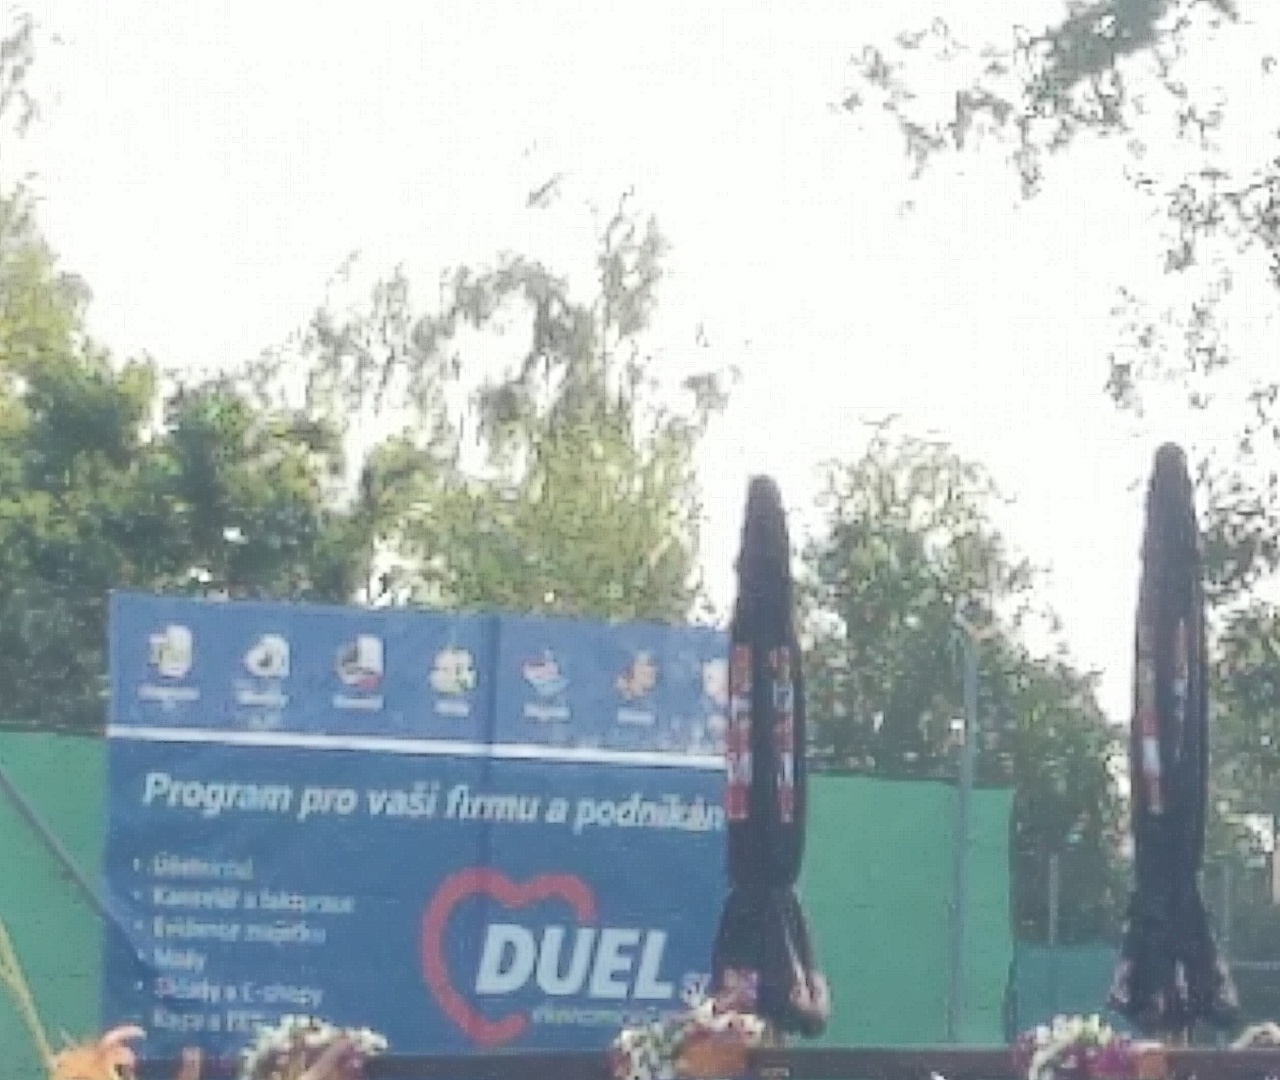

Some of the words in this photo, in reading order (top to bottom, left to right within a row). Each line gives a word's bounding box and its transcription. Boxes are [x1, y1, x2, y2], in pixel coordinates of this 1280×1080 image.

[145, 771, 292, 817] Program
[296, 785, 358, 822] pro
[366, 780, 440, 818] vaši
[447, 784, 541, 823] firmu
[545, 796, 570, 824] a
[572, 791, 727, 835] podnikán
[474, 922, 675, 1000] DUEL
